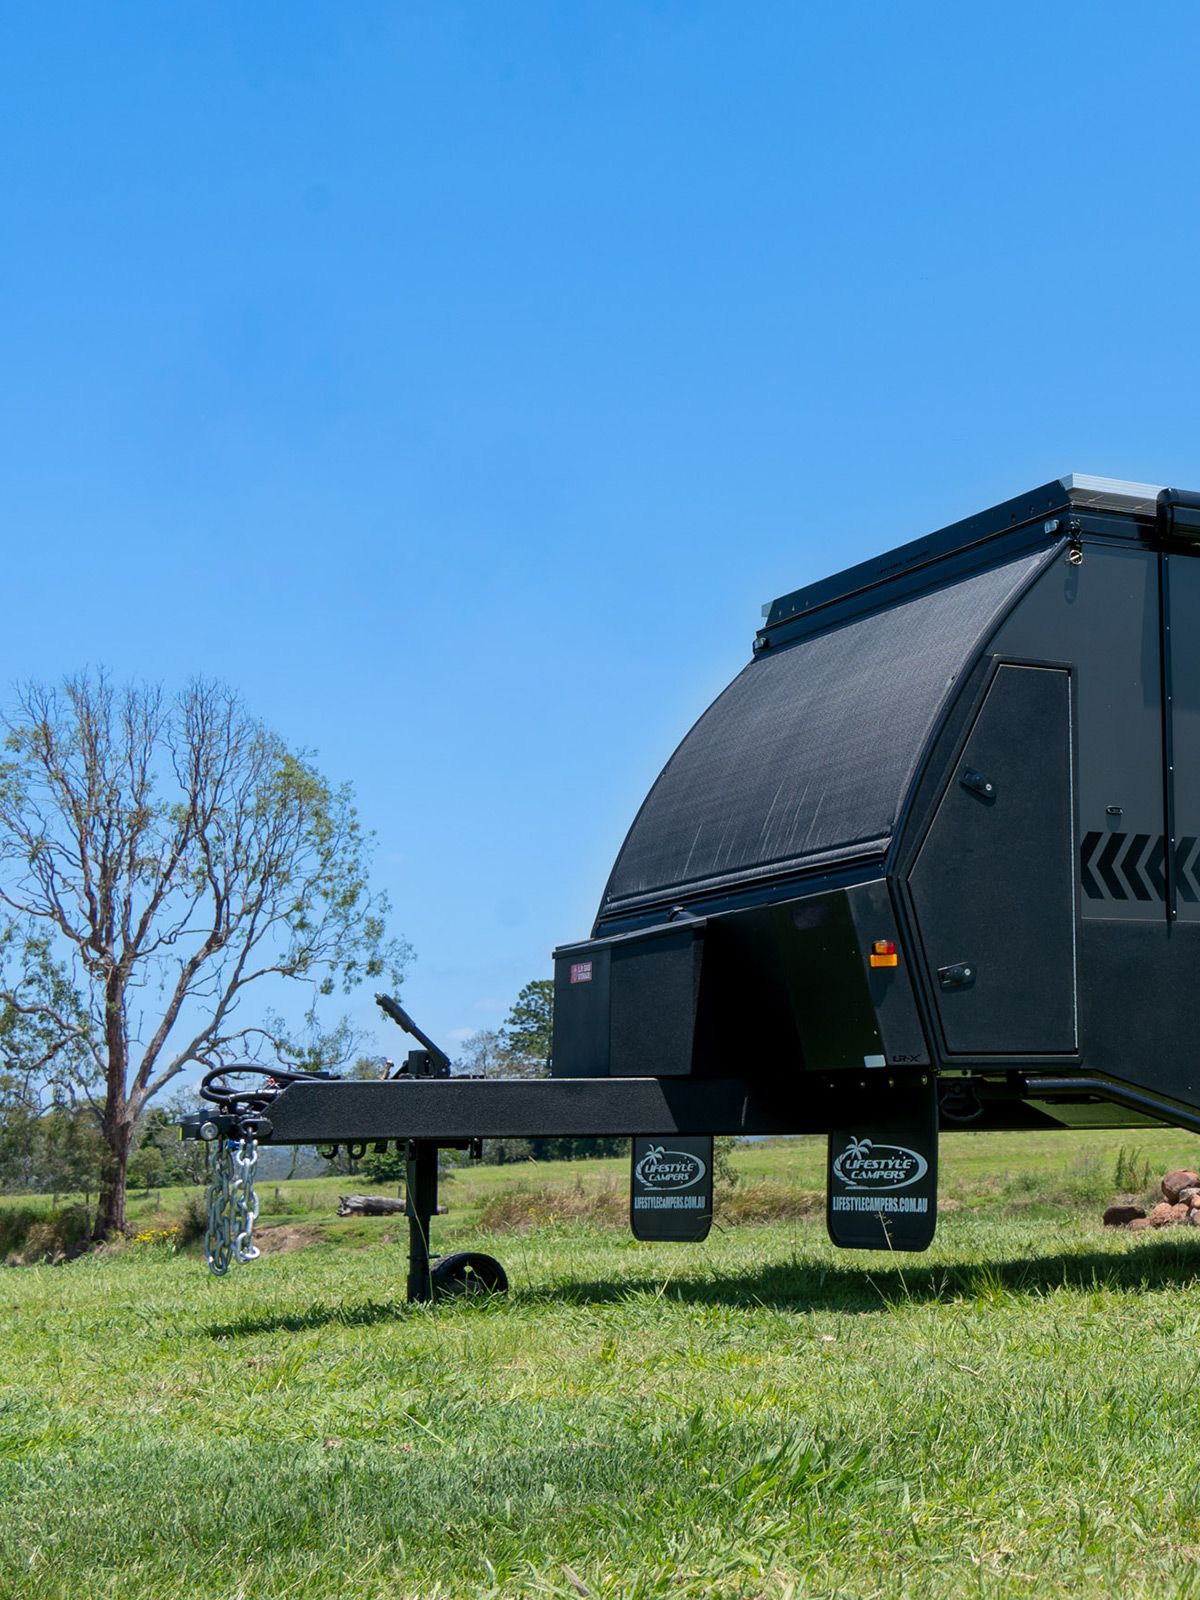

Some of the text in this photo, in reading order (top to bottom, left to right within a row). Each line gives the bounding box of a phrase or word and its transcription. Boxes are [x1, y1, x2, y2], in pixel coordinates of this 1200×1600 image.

[645, 1163, 694, 1173] LIFESTYLE
[845, 1159, 913, 1169] LIFESTYLE
[649, 1173, 690, 1181] CAMPERS
[851, 1170, 906, 1179] CAMPERS
[832, 1196, 928, 1213] LIFESTYLECAMPERS.COM.AU
